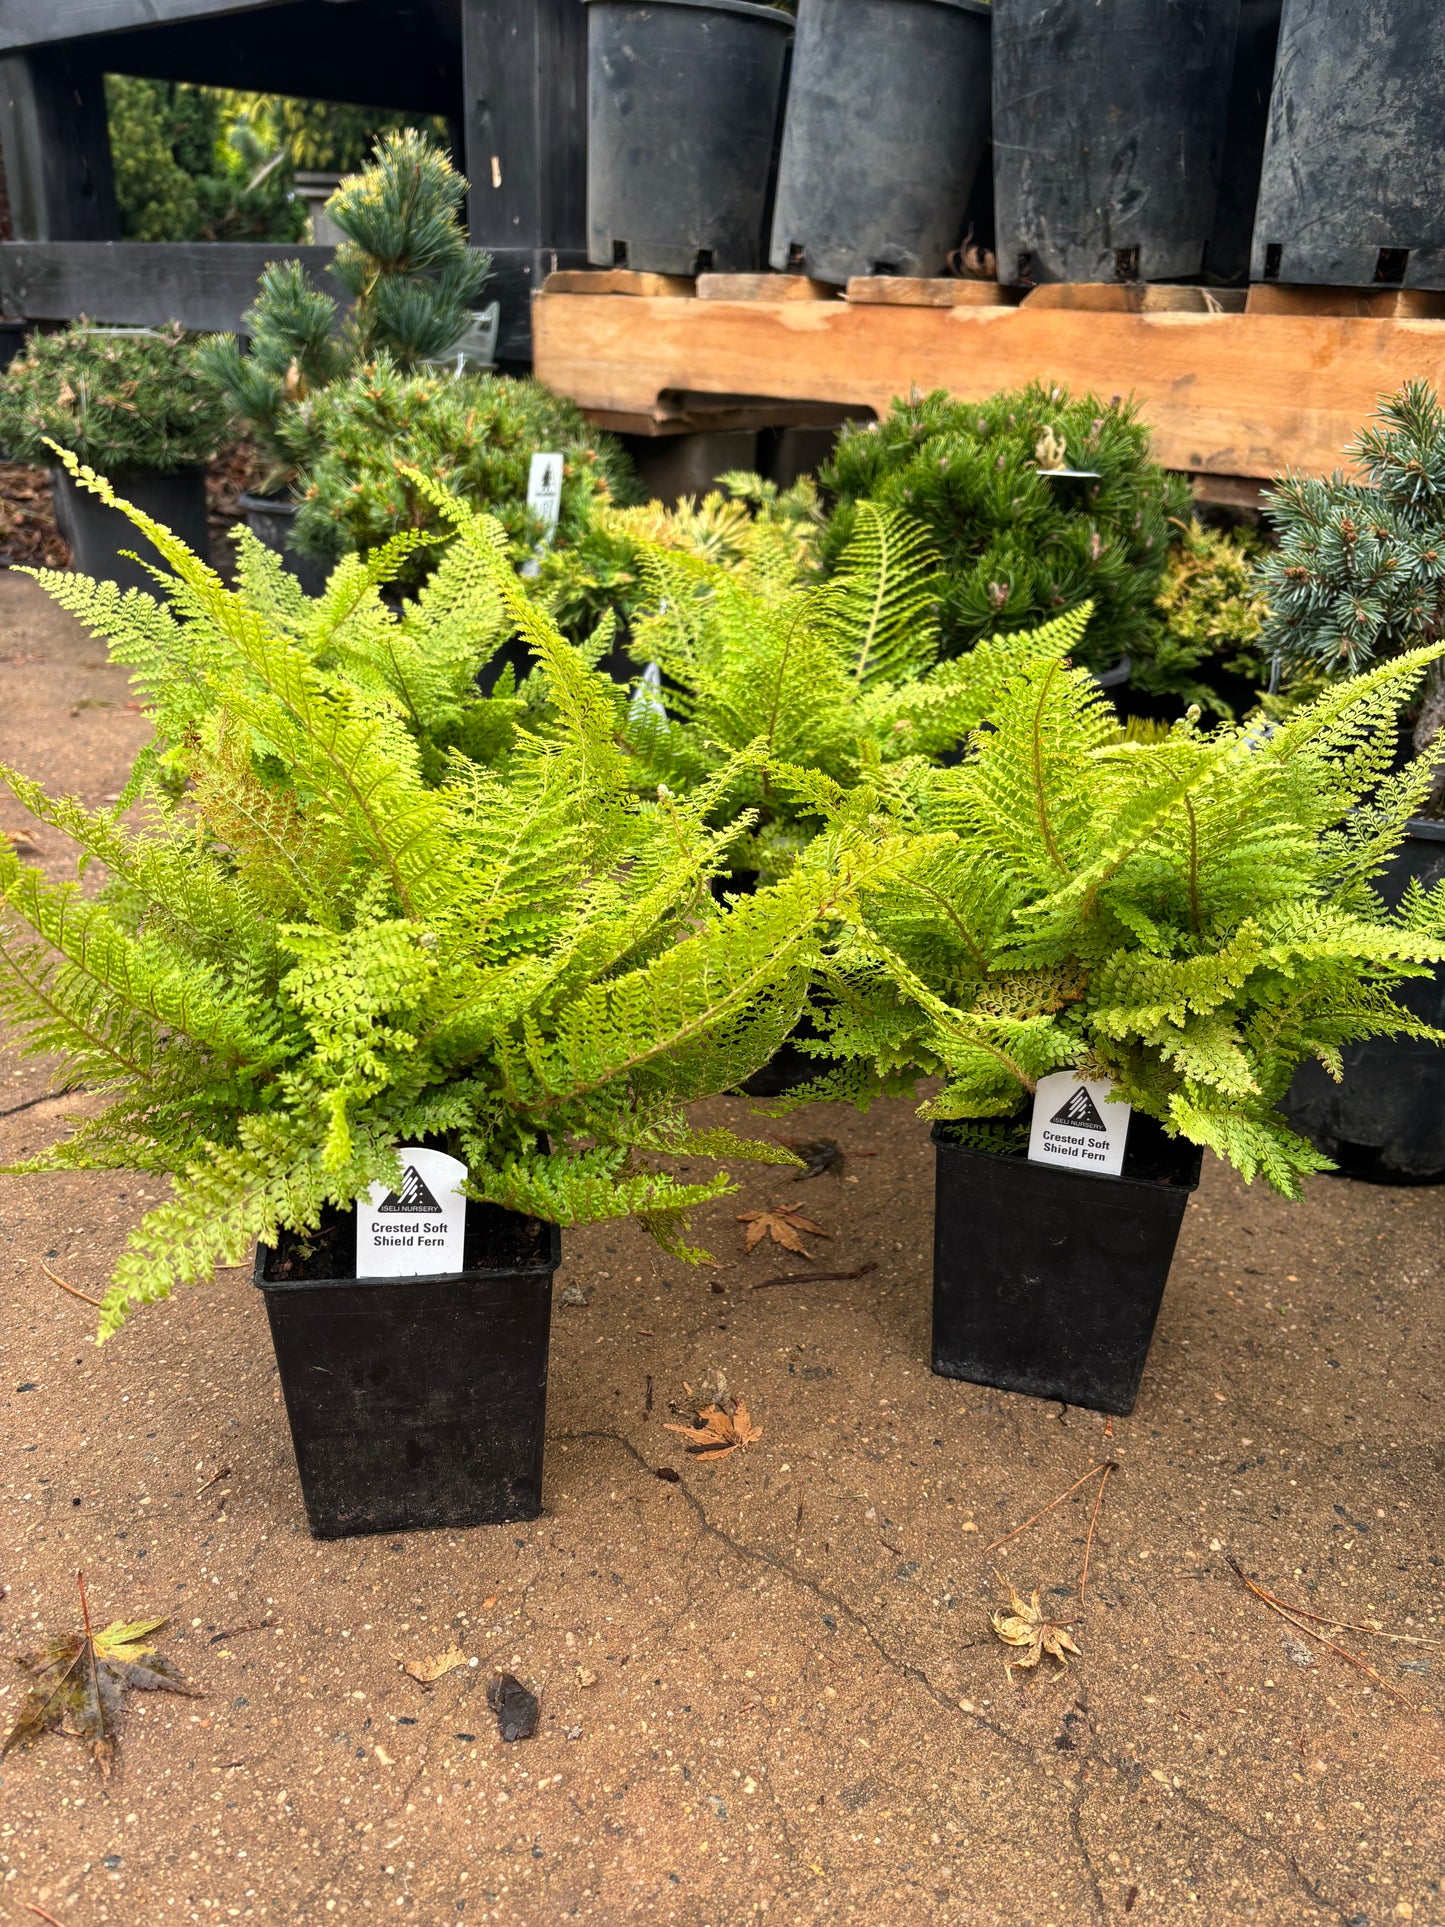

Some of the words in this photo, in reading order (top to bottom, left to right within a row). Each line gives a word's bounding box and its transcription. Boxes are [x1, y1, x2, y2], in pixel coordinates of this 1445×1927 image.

[1070, 1120, 1104, 1130] NURSERY
[1043, 1130, 1085, 1146] Crested
[1087, 1138, 1110, 1150] Soft
[1043, 1142, 1079, 1157] Shield
[1081, 1149, 1106, 1161] Fern
[371, 1222, 419, 1233] Crested
[423, 1222, 448, 1233] Soft
[373, 1236, 414, 1246] Shield
[418, 1236, 444, 1246] Fern
